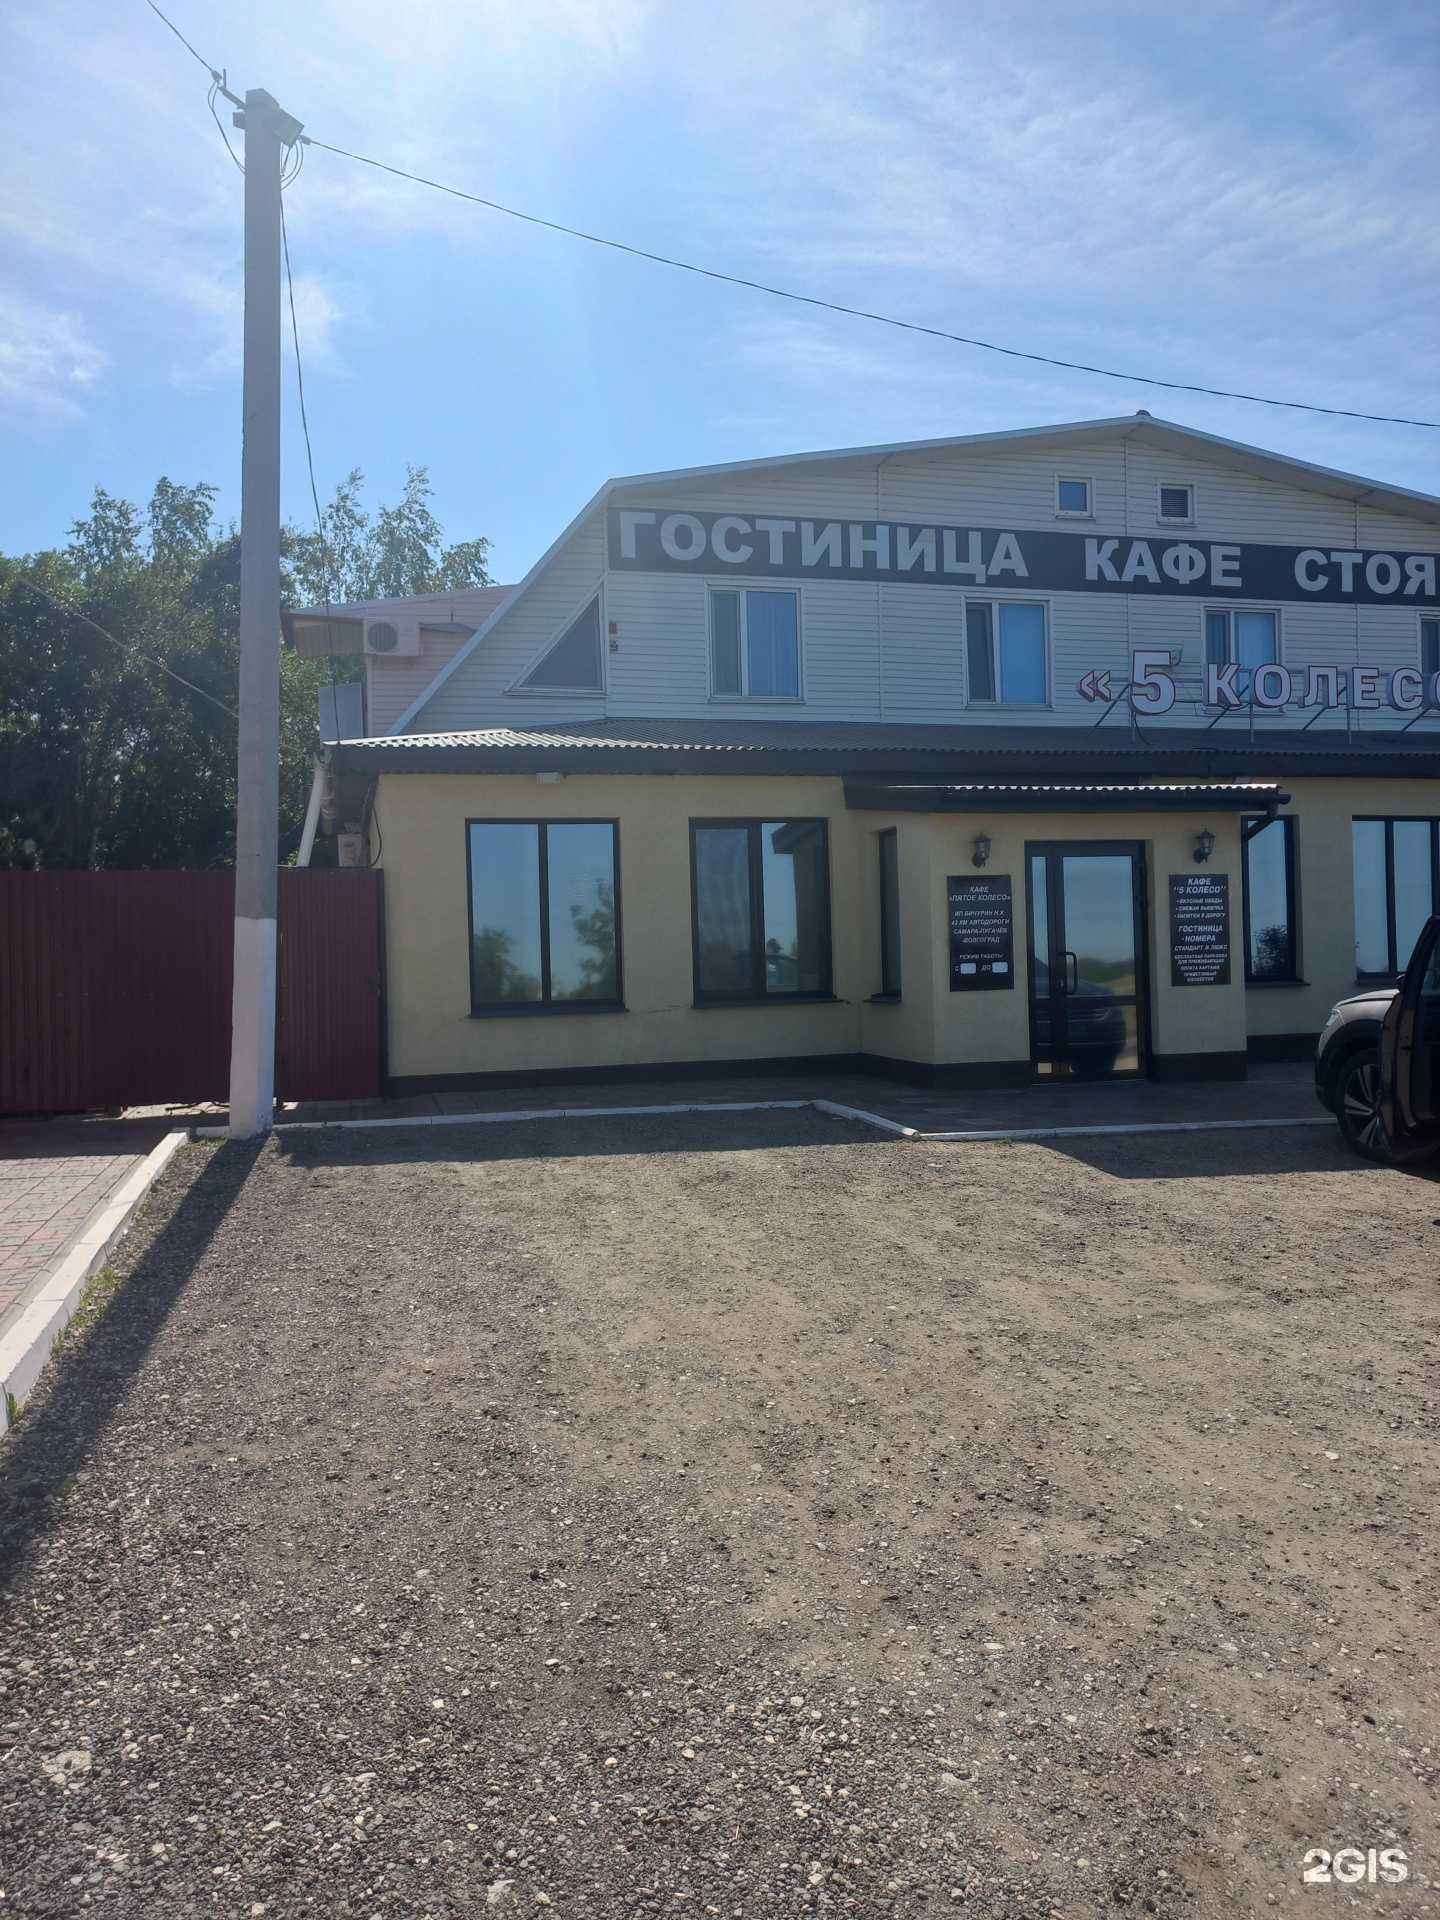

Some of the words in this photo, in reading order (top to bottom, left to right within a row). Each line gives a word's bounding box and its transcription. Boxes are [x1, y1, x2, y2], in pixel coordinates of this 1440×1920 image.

[618, 510, 1030, 585] ГОСТИНИЦА
[1084, 537, 1243, 587] КАФЕ
[1294, 549, 1437, 597] СТОЯ
[1187, 877, 1212, 886] КАФЕ
[1178, 924, 1223, 932] ГОСТИНИЦА
